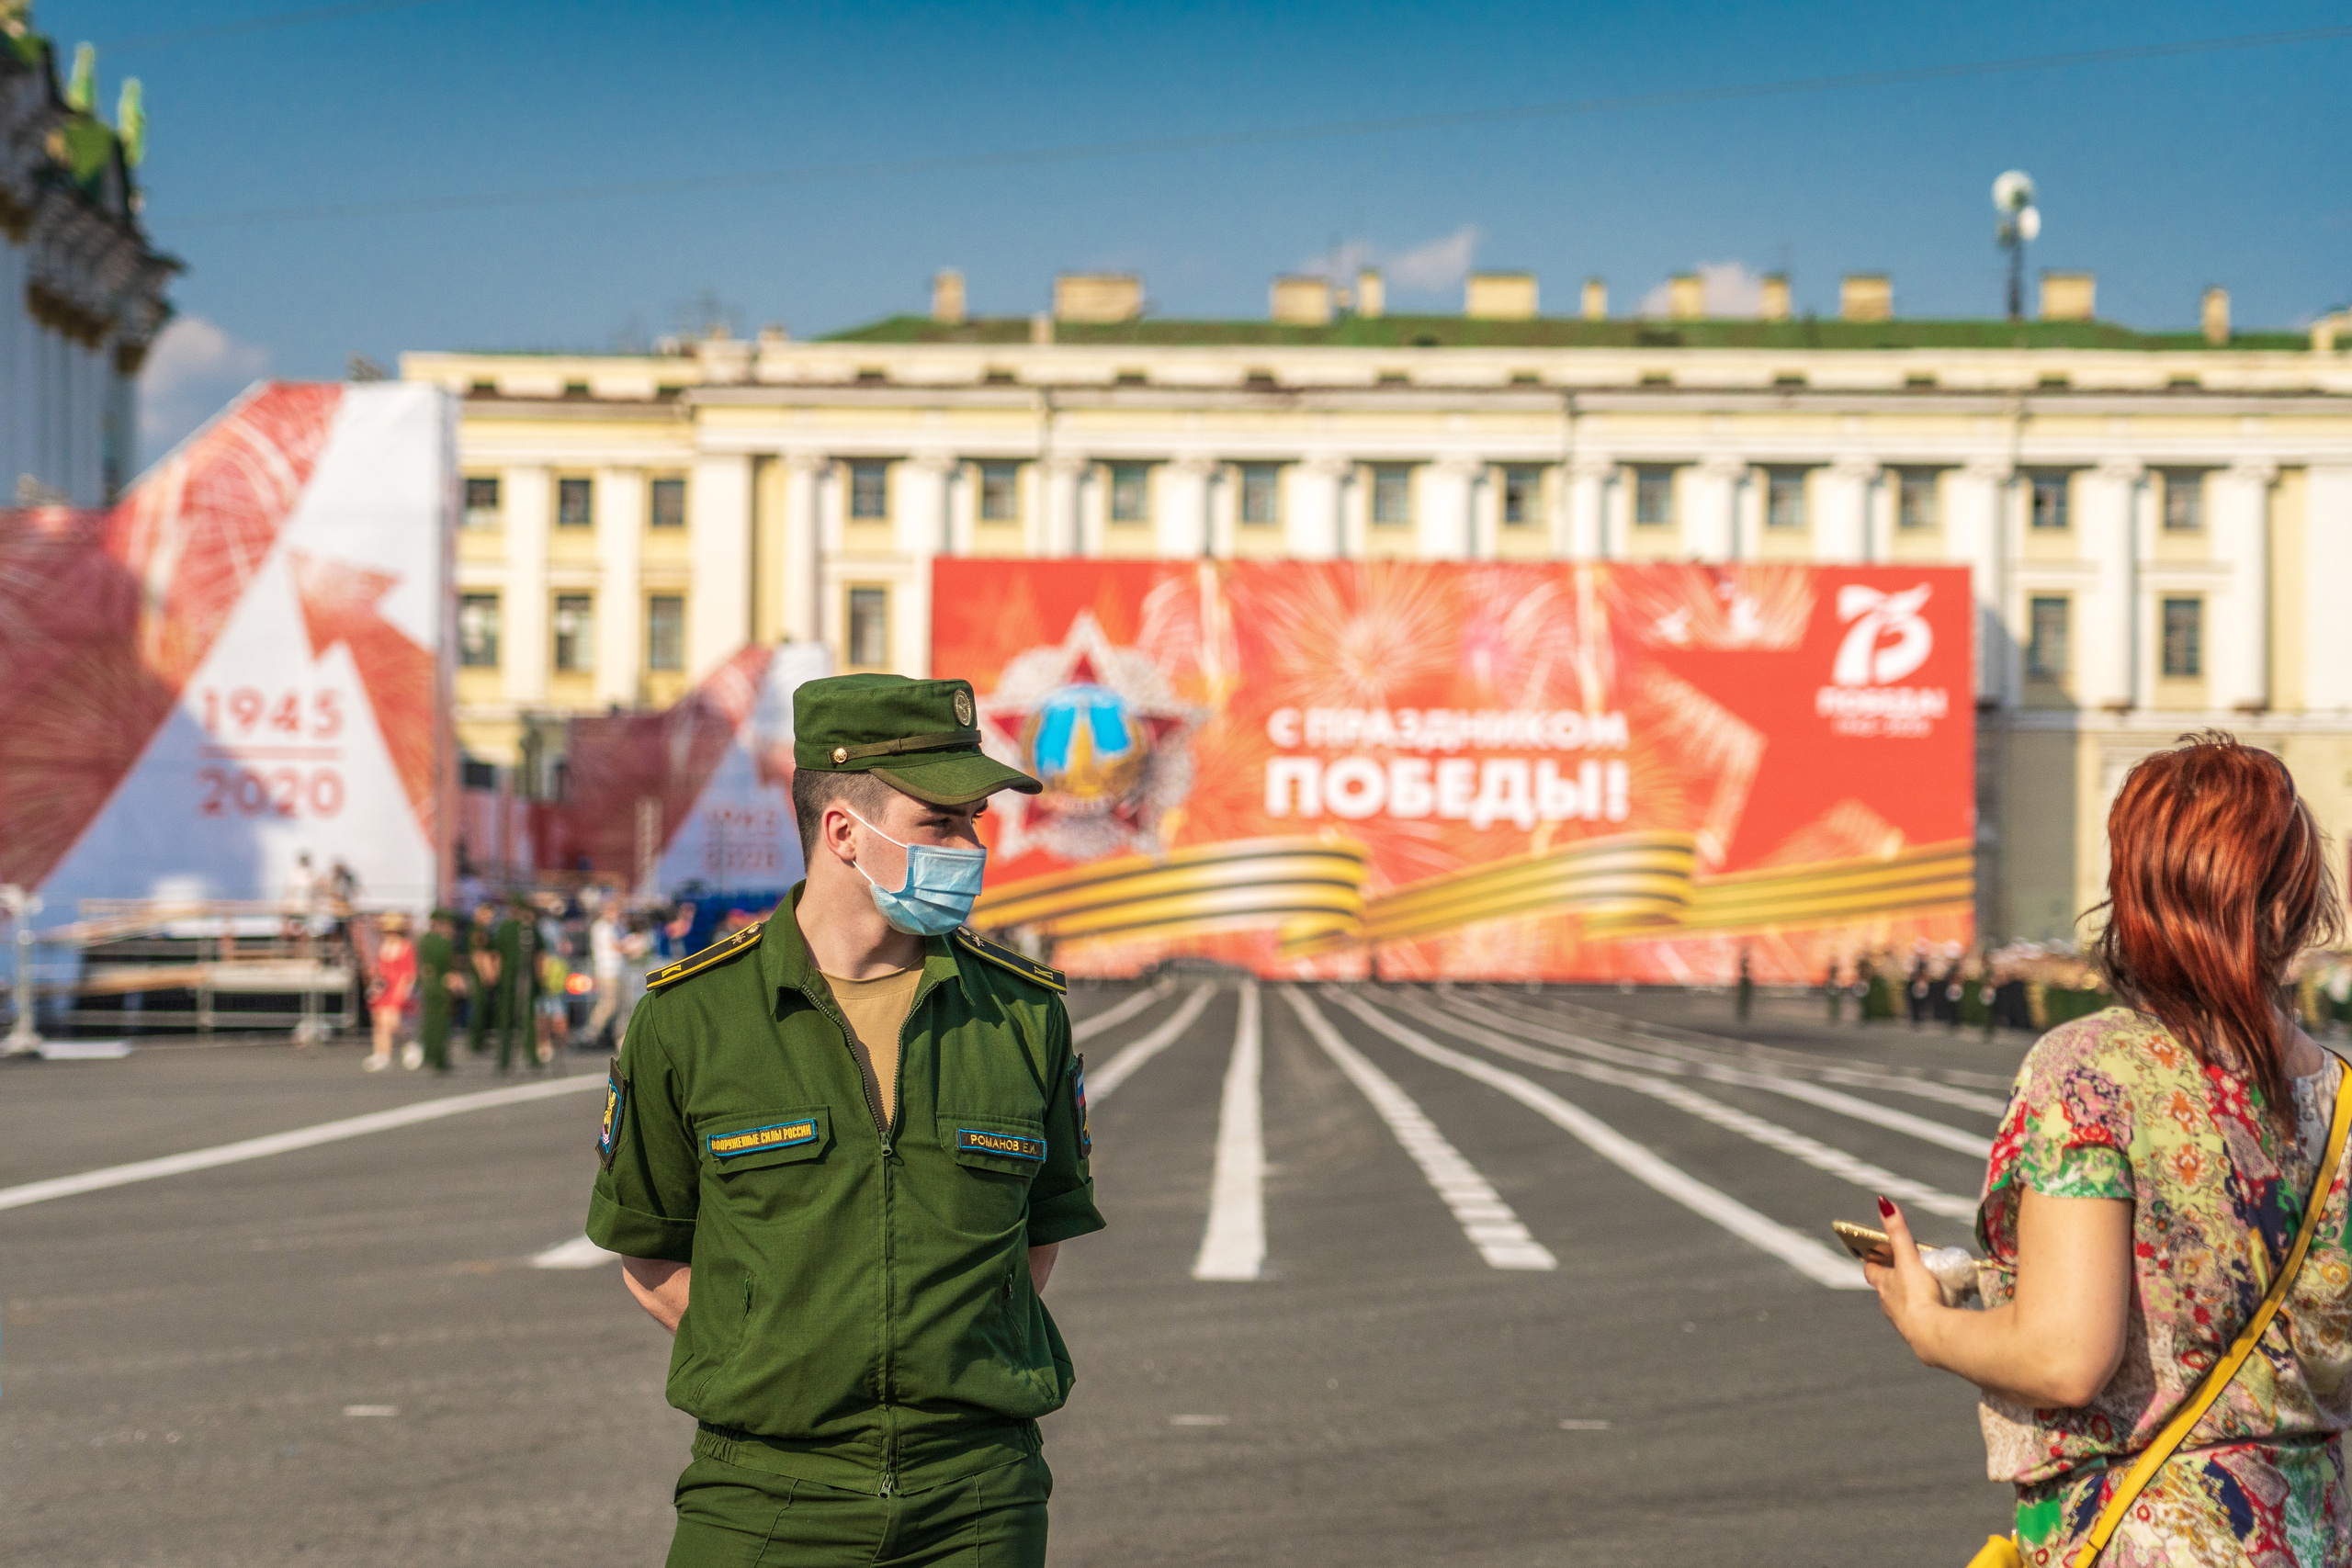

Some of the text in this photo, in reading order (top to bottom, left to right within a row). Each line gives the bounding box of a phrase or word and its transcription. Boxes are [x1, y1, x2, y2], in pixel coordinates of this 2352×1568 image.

[204, 688, 344, 738] 1945
[1267, 706, 1630, 753] С ПРАЗДНИКОМ
[195, 765, 345, 818] 2020
[1264, 756, 1630, 830] ПОБЕДЫ!
[711, 1123, 812, 1151] ВООРУЖЕННЫЕ СИЛЫ РОССИИ
[970, 1134, 1020, 1151] РОМАНОВ
